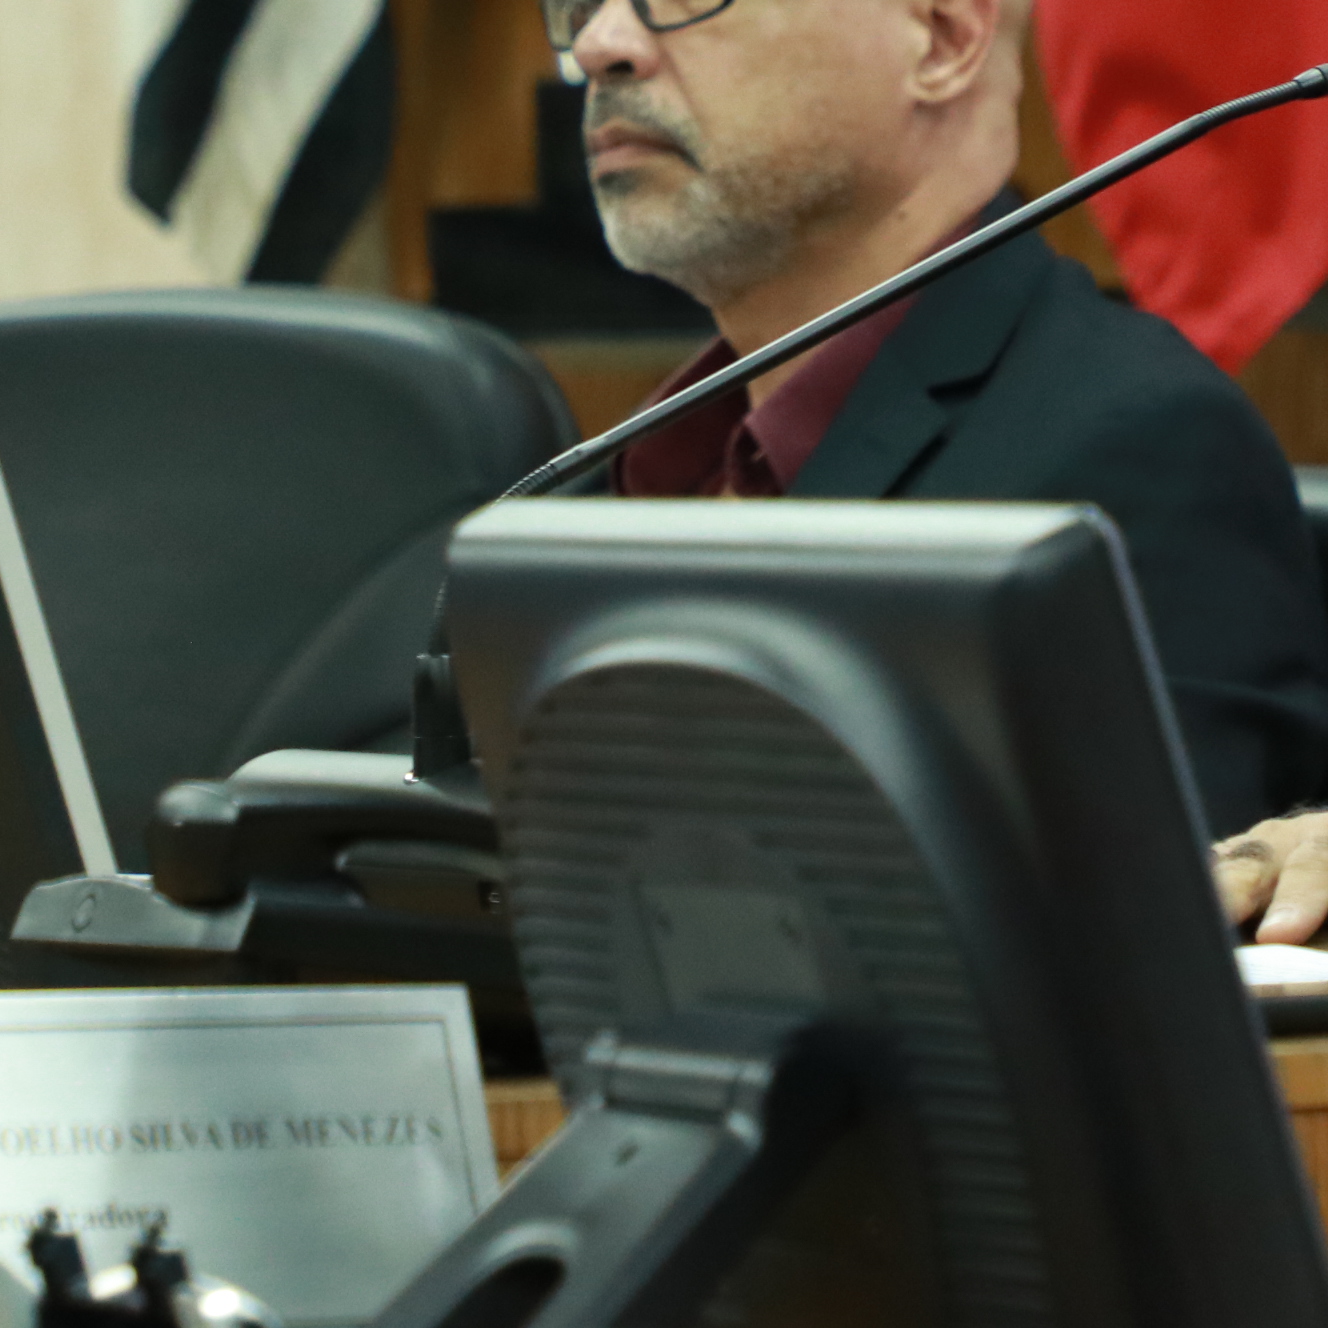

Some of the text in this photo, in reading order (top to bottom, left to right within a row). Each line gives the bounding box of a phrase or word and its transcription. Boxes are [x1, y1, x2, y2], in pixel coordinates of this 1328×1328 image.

[128, 1119, 226, 1154] SILVA
[229, 1117, 277, 1151] DE
[283, 1110, 446, 1149] MENEZES
